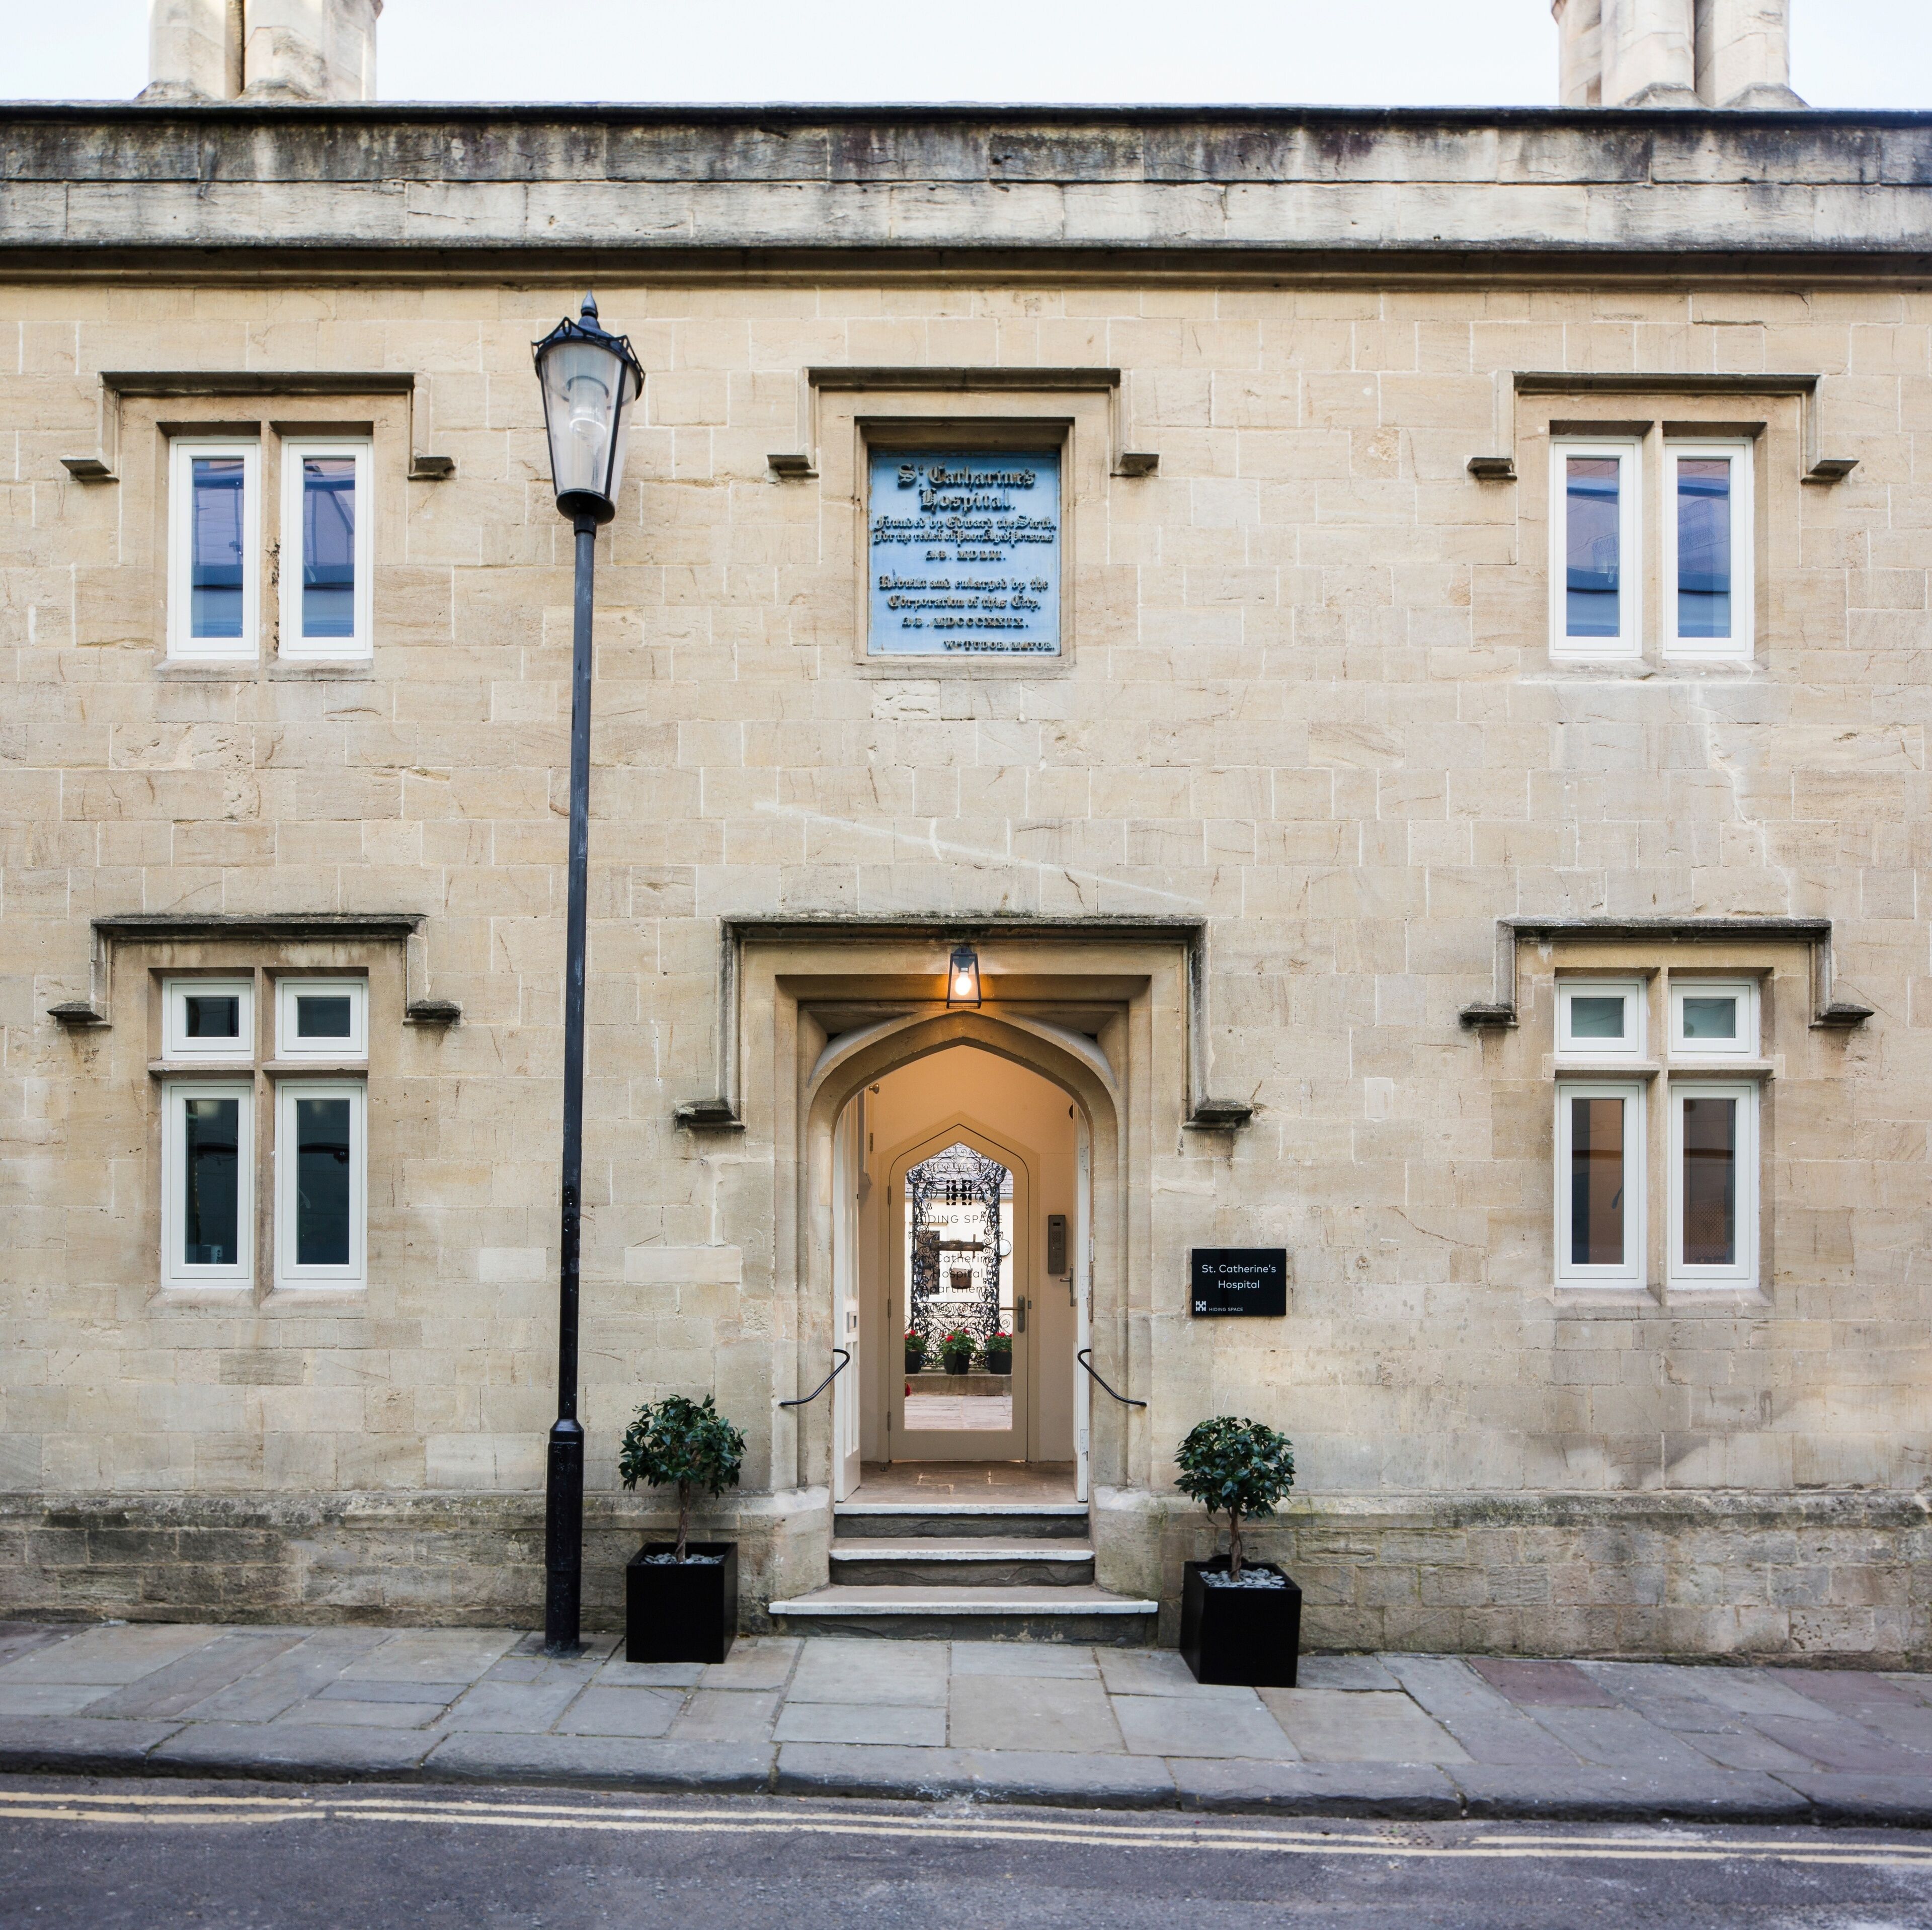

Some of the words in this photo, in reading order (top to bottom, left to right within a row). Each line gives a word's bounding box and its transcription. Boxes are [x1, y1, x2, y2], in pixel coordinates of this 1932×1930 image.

[928, 464, 1035, 492] Catharine's
[873, 515, 925, 531] Founded
[926, 516, 944, 529] by
[946, 515, 993, 529] Edward
[997, 516, 1015, 532] the
[897, 529, 912, 545] the
[914, 529, 944, 541] relief
[944, 529, 957, 541] of
[956, 529, 983, 547] Poor
[982, 529, 1009, 545] Aged
[879, 575, 927, 590] Rebuilt
[930, 578, 951, 589] and
[955, 577, 1007, 592] enlarged
[1011, 577, 1026, 593] by
[1030, 575, 1048, 593] the
[888, 594, 964, 612] Corporation
[967, 596, 980, 608] of
[982, 595, 1007, 612] this
[933, 1268, 983, 1280] Hospital
[1201, 1264, 1216, 1273] St.
[1219, 1264, 1276, 1273] Catherine's
[1218, 1280, 1259, 1290] Hospital
